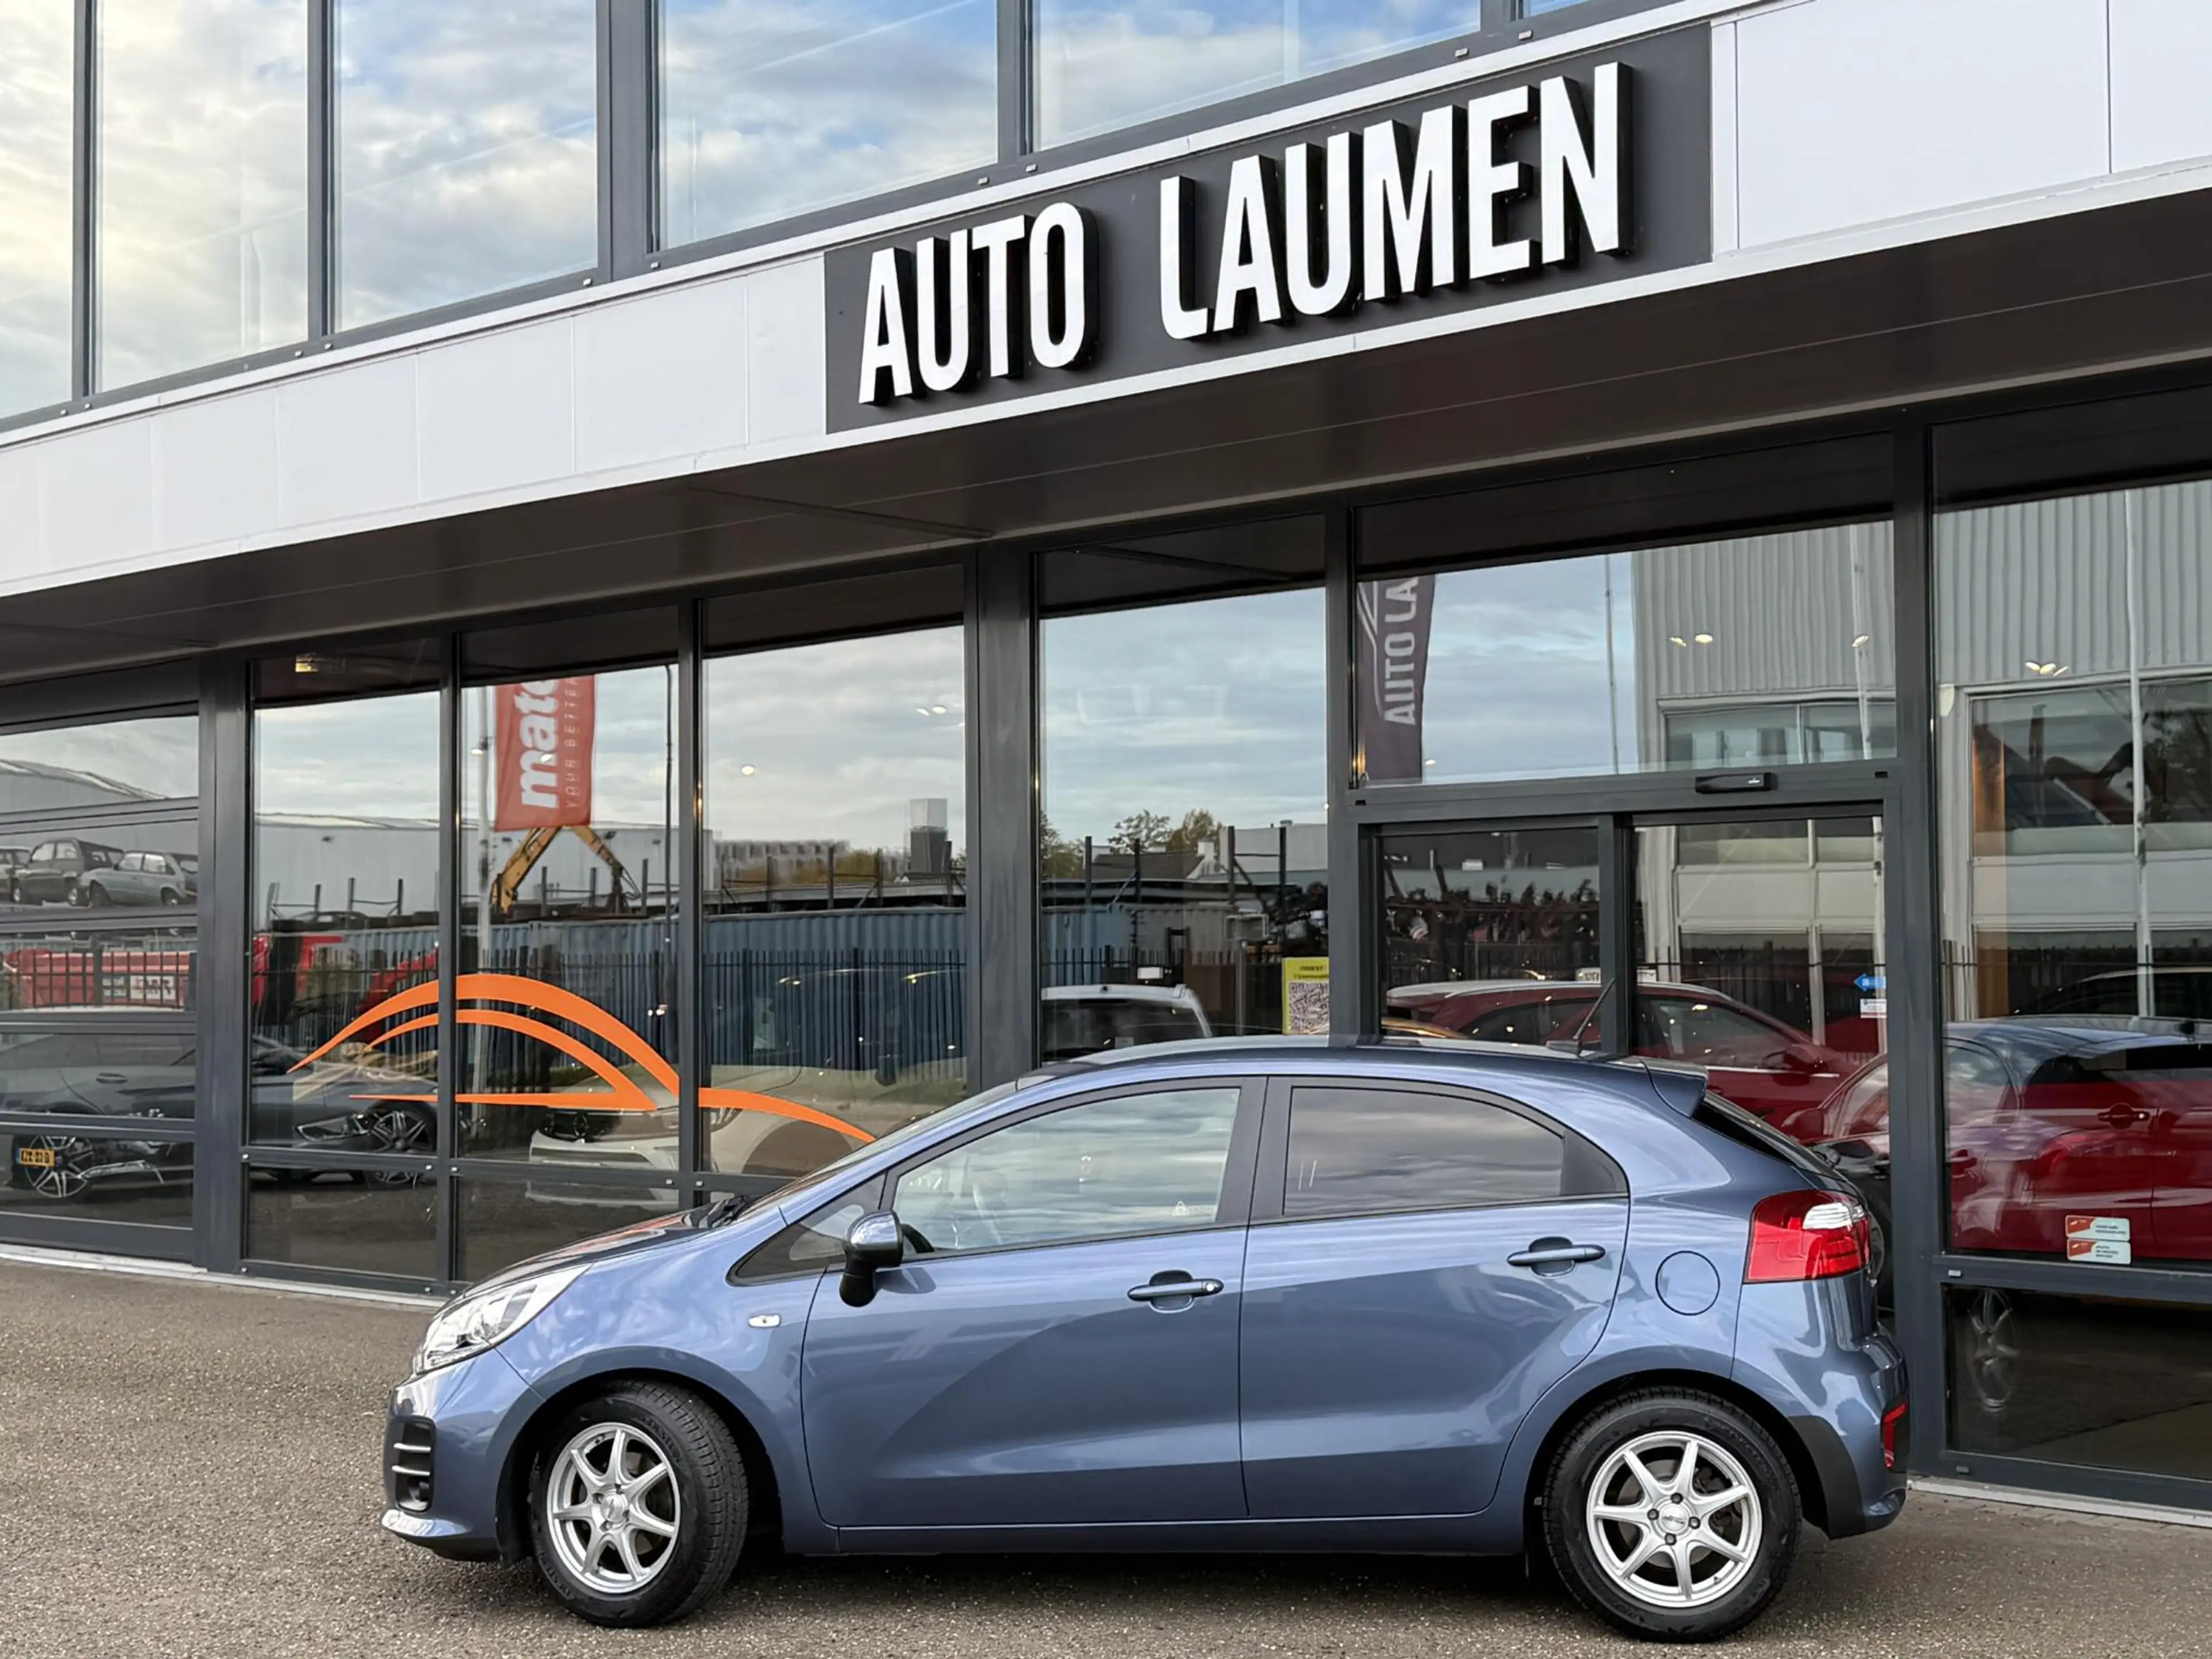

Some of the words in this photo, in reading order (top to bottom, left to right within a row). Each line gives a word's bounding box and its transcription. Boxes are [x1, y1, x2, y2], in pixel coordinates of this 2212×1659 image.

[858, 202, 1086, 404] AUTO
[1160, 62, 1620, 339] LAUMEN
[1384, 632, 1415, 725] AUTO
